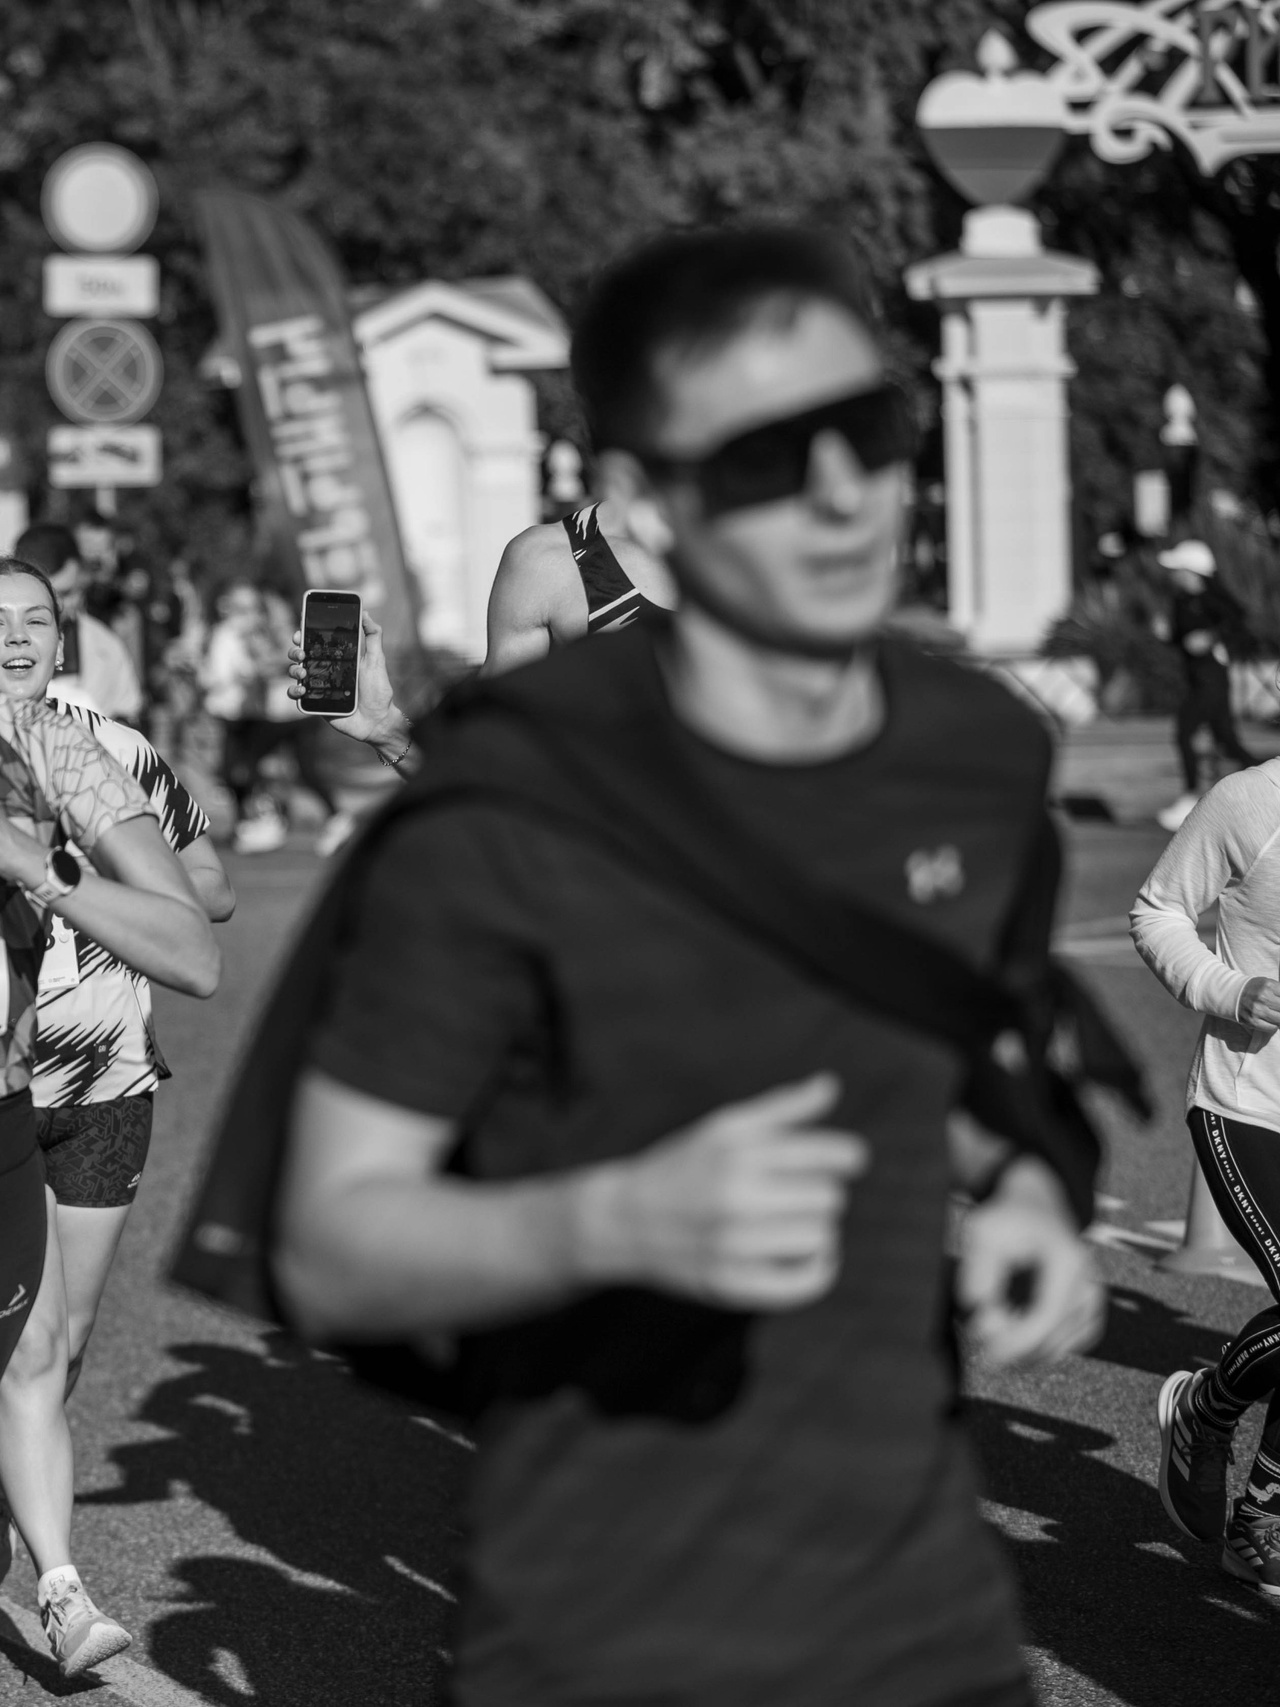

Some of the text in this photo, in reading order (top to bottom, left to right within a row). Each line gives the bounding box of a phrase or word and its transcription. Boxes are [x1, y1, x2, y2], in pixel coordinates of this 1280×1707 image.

[1212, 1129, 1227, 1159] DKNY
[1223, 1160, 1235, 1181] SPORT
[1233, 1185, 1253, 1214] DKNY
[1250, 1214, 1265, 1235] SPORT
